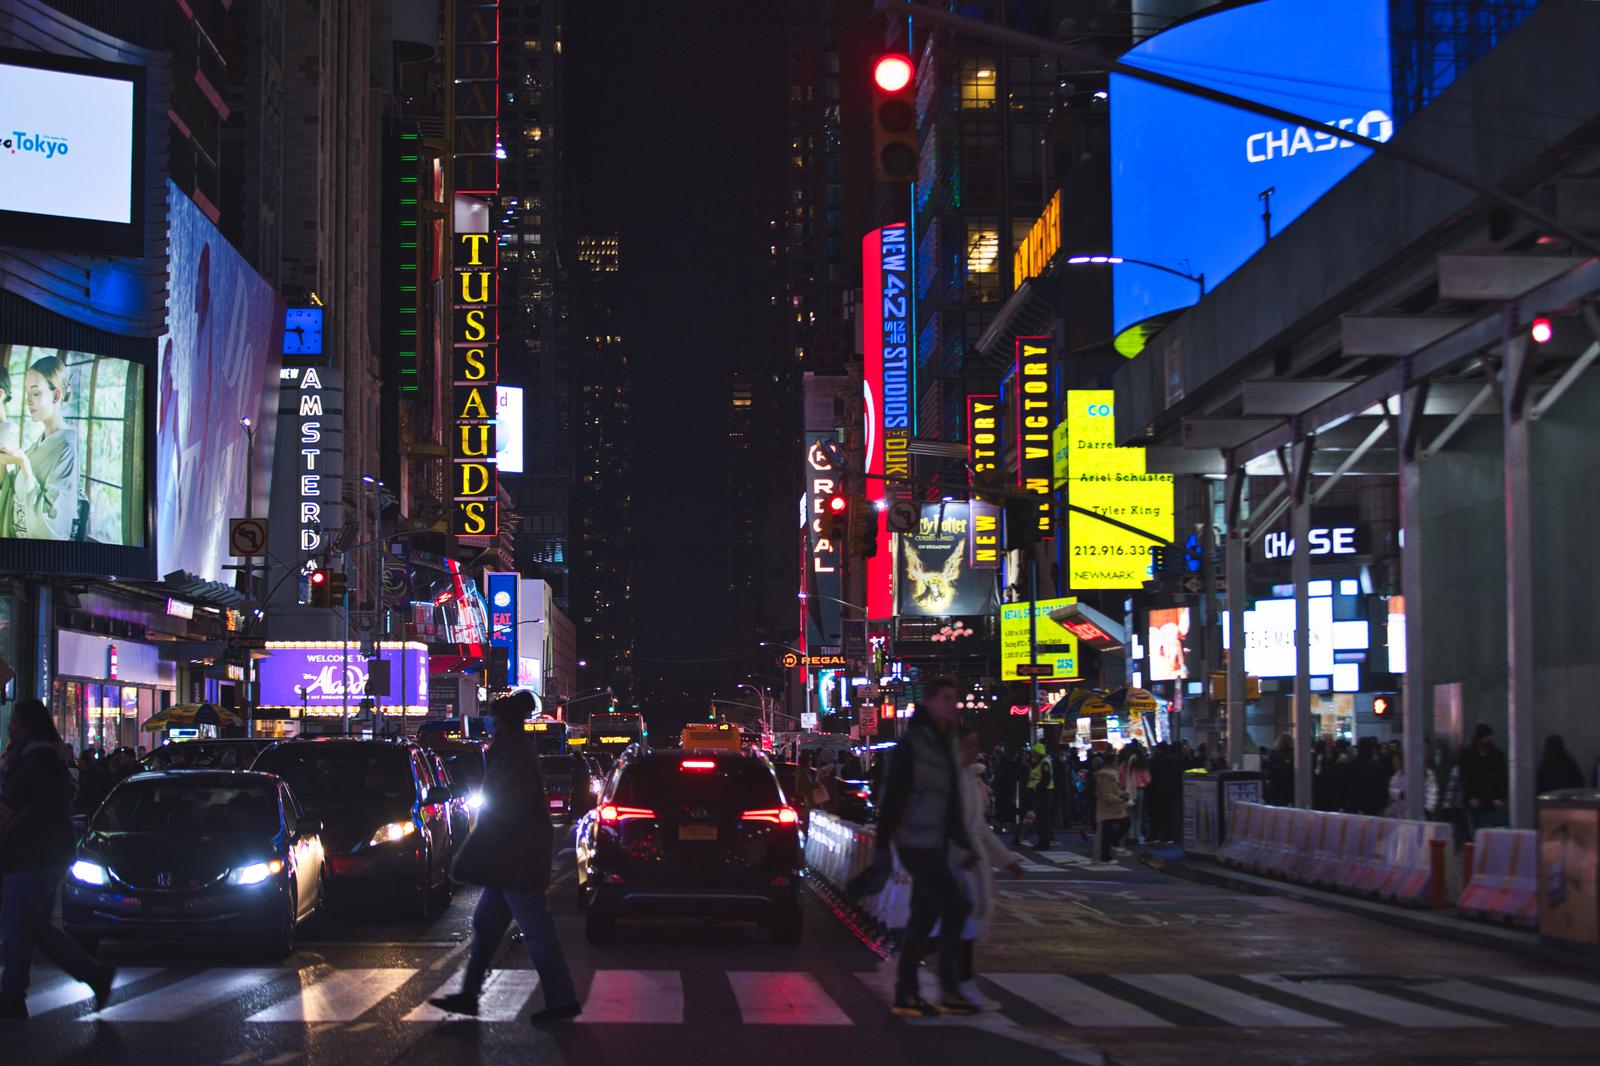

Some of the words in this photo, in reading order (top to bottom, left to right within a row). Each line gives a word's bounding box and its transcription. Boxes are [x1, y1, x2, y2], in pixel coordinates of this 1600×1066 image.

[13, 131, 69, 159] Tokyo
[1247, 118, 1354, 163] CHASE
[882, 229, 906, 271] NEW
[279, 368, 299, 379] NEW
[459, 234, 491, 534] TUSSAUD'S
[883, 346, 908, 428] STUDIOS
[1023, 345, 1049, 459] VICTORY
[1088, 405, 1115, 416] CO
[974, 402, 996, 501] CTORY
[1078, 440, 1113, 449] Darre
[300, 367, 322, 577] AMSTERDA
[1080, 473, 1111, 481] Ariel
[1092, 505, 1126, 516] Tyler
[1130, 505, 1160, 517] King
[975, 515, 996, 561] NEW
[1074, 545, 1153, 556] 212.916.336
[1074, 571, 1135, 580] NEWMARK
[801, 656, 846, 664] REGAL
